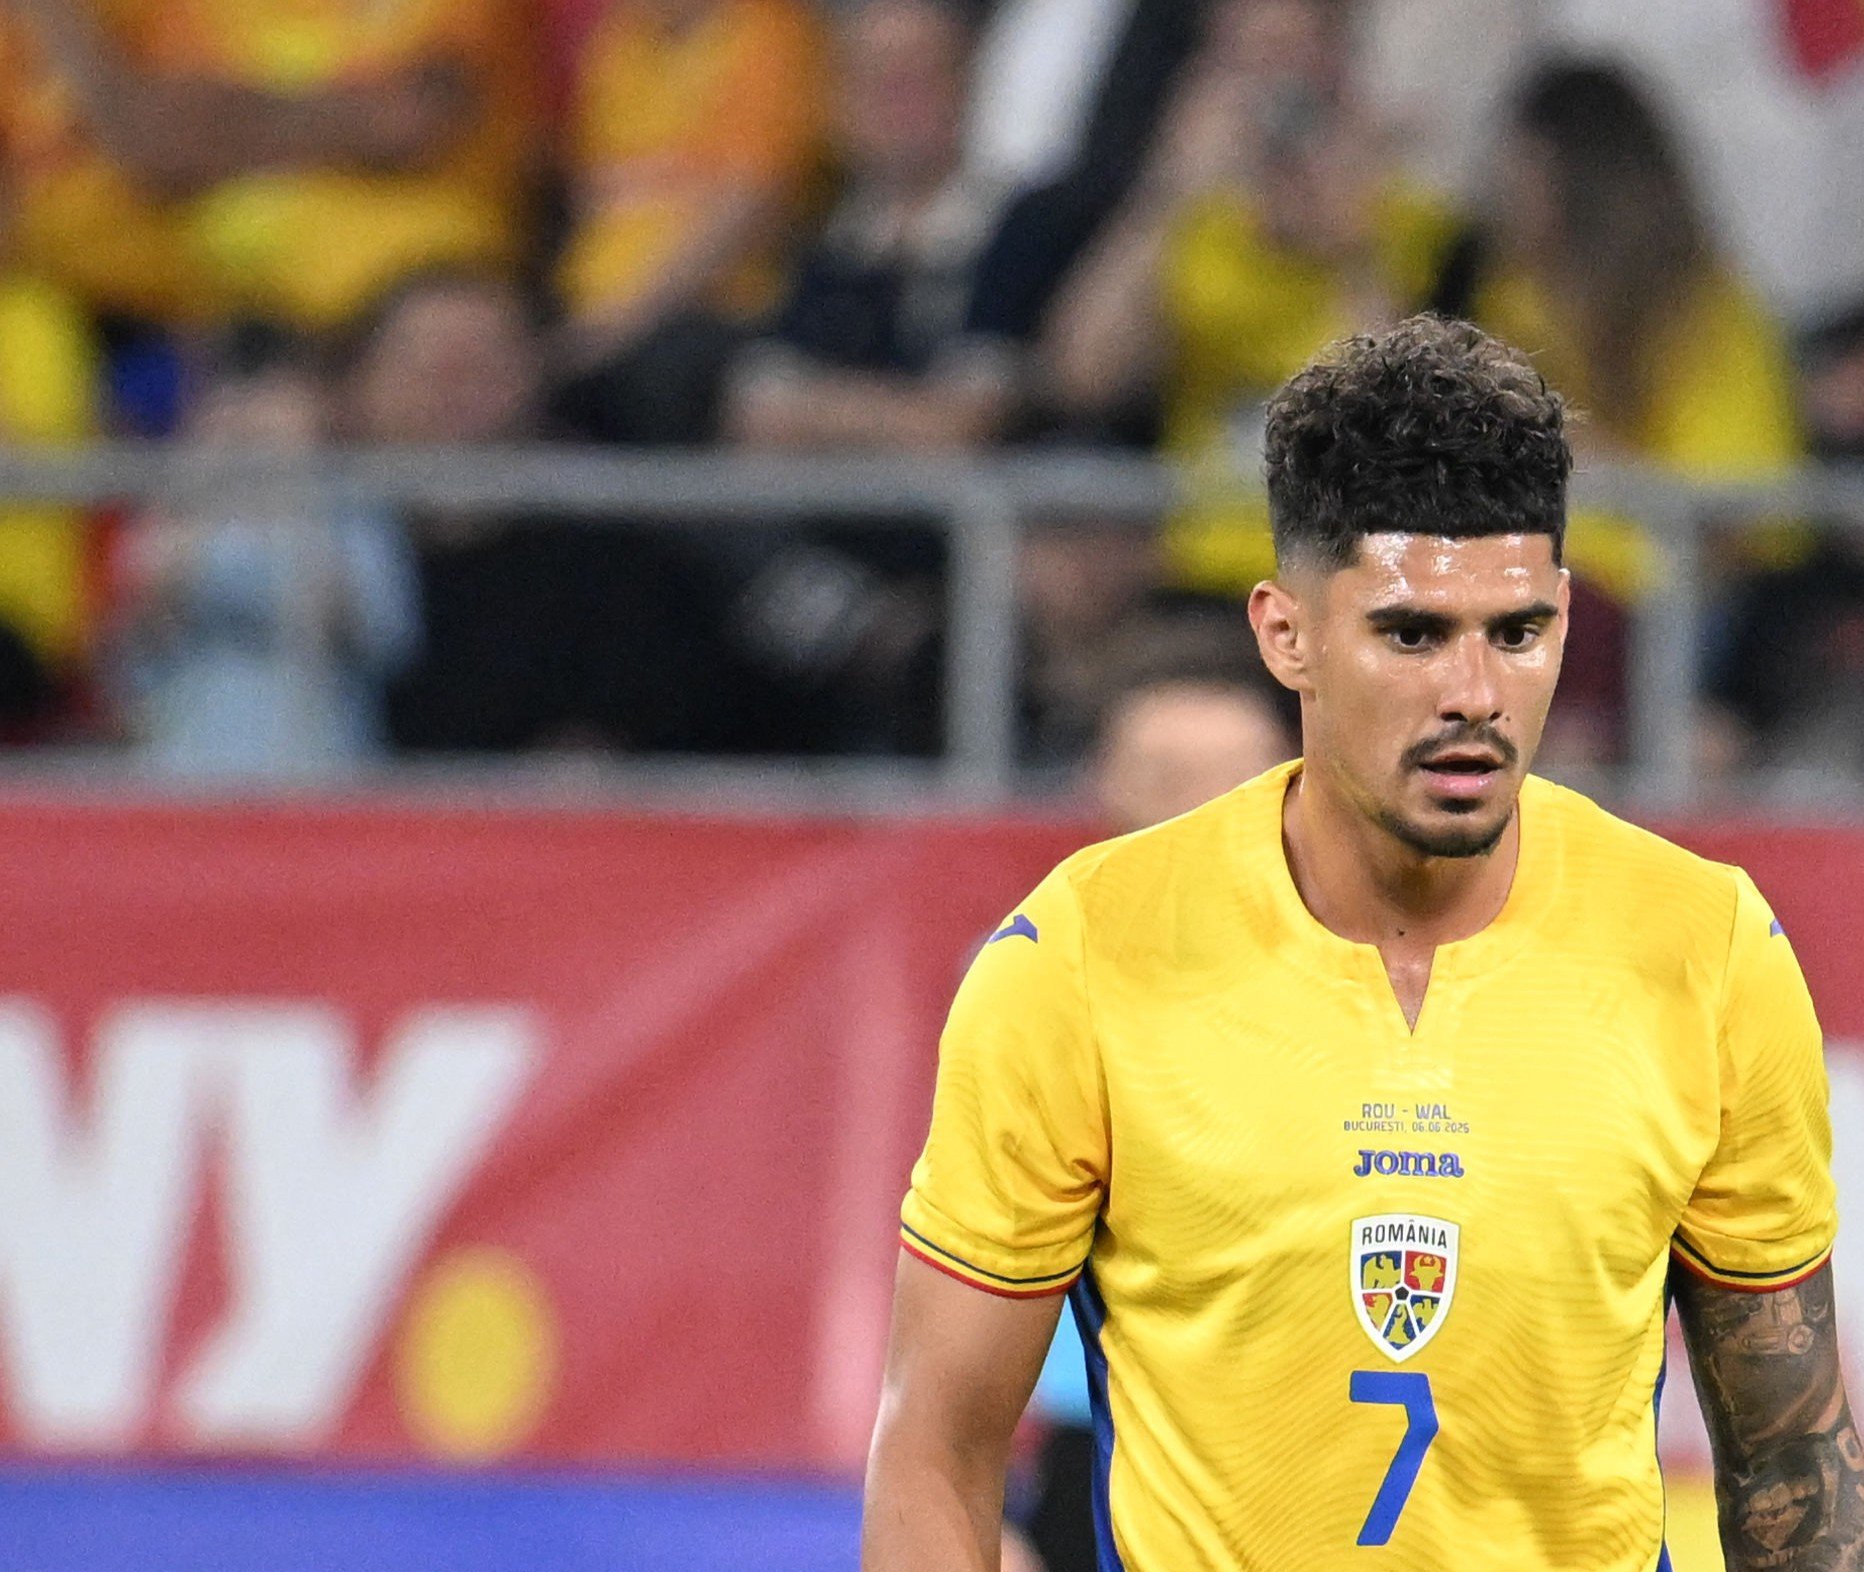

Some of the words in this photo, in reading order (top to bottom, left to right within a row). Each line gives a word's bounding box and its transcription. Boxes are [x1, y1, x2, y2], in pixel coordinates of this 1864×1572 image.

[1361, 1103, 1395, 1119] ROU
[1415, 1103, 1452, 1120] WAL
[1361, 1218, 1448, 1249] ROMÂNIA
[1349, 1370, 1439, 1546] 7
